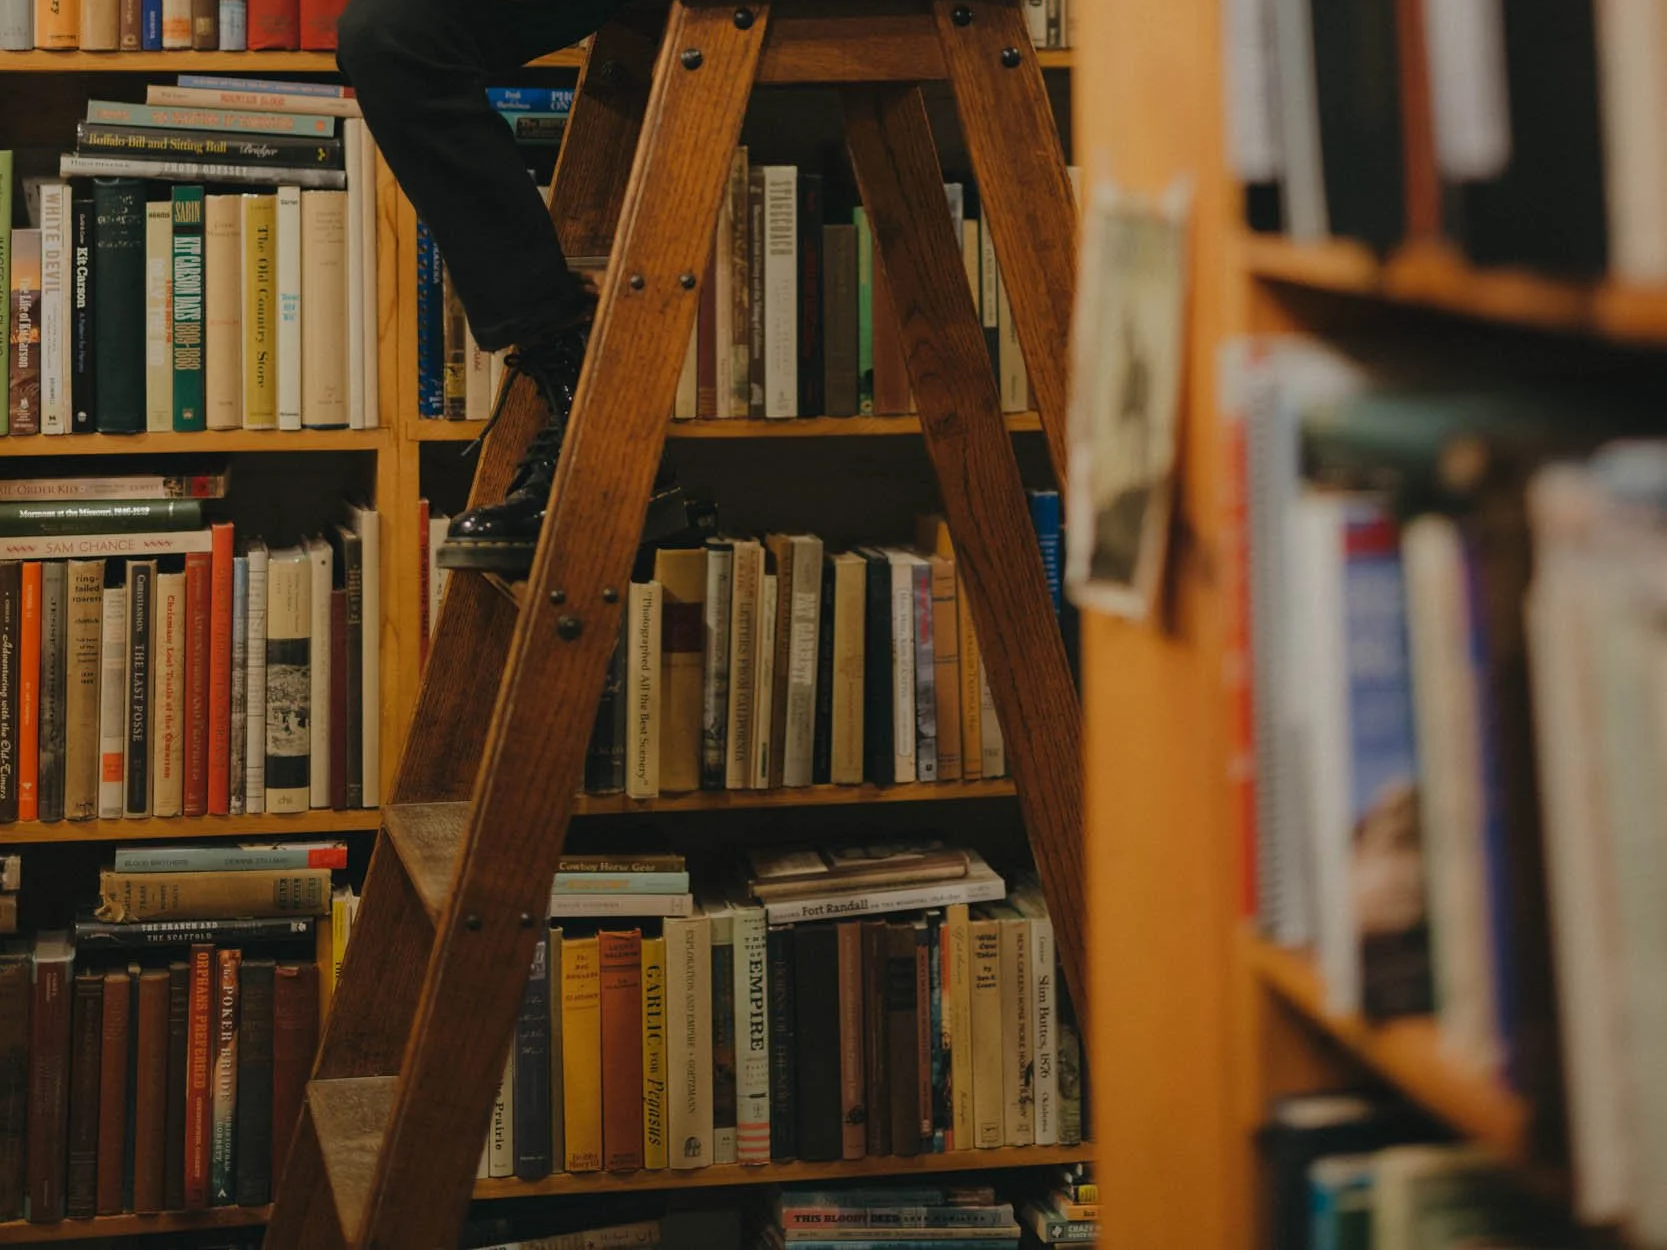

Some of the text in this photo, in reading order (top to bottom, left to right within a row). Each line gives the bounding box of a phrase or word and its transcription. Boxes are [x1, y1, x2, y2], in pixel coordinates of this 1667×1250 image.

[89, 134, 126, 147] Buffalo
[127, 135, 145, 148] Bill
[146, 135, 167, 149] and
[169, 137, 203, 153] Sitting
[206, 141, 227, 154] Bull
[163, 162, 248, 176] PHOTO ODYSSEY
[175, 201, 201, 223] SABIN
[769, 180, 793, 256] STAGECOACH
[45, 192, 60, 295] WHITE DEVIL
[76, 246, 88, 309] Kit Carson
[174, 236, 201, 370] KIT CARSON DAYS 1809-1868
[256, 225, 268, 388] The Old Country Store
[18, 295, 31, 368] Life of Kit Carson
[20, 508, 56, 518] Mormons
[56, 508, 65, 517] at
[66, 508, 78, 517] the
[46, 540, 136, 553] SAM CHANCE
[75, 574, 99, 584] ring-
[75, 583, 100, 592] tailed
[792, 591, 816, 686] PAT GARRETT
[134, 644, 145, 670] THE
[166, 647, 175, 668] Lost
[133, 672, 144, 700] LAST
[165, 670, 175, 700] Trails
[636, 591, 653, 786] "Photographed All the Best Scenery"
[735, 602, 753, 762] LETTERS FROM CALIFORNIA
[0, 634, 13, 799] Adventuring with the Old-Timers
[165, 714, 175, 731] the
[166, 702, 174, 713] of
[132, 704, 144, 742] POSSE
[124, 859, 190, 868] BLOOD BROTHERS
[559, 861, 656, 873] Cowboy Horse Gear
[802, 899, 869, 917] Fort Randall
[141, 920, 218, 932] THE BRANCH AND
[147, 933, 213, 942] THE SCAFFOLD
[194, 952, 209, 1088] ORPHANS PREFERRED
[749, 959, 765, 1051] EMPIRE
[219, 962, 234, 1102] The POKER BRIDE
[685, 930, 697, 1114] EXPLORATION AND EMPIRE GOETZMANN
[645, 964, 664, 1146] GARLIC FOR Pegasus
[1037, 975, 1053, 1133] Slim Buttes, 1876 Oklahoma
[494, 1099, 505, 1148] Prairie
[794, 1213, 901, 1224] THIS BLOODY DEED
